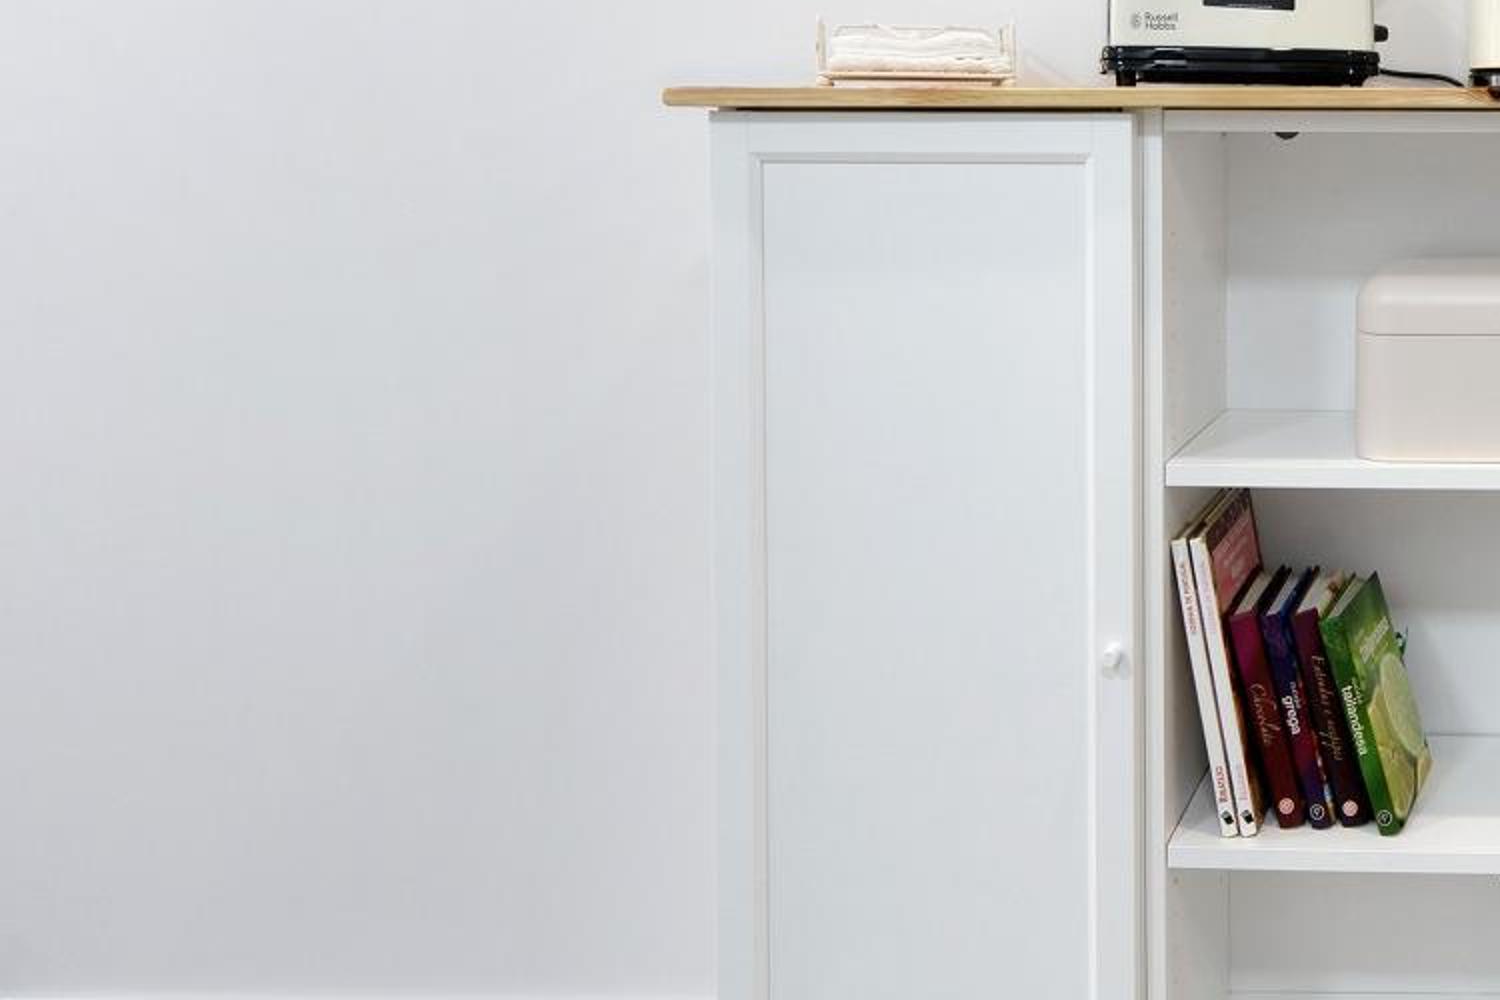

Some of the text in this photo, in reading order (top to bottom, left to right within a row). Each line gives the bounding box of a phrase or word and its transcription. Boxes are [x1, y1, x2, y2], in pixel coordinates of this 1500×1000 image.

[1144, 11, 1179, 22] Russell
[1144, 21, 1176, 31] Hobbs
[1281, 695, 1301, 736] grega
[1341, 684, 1368, 757] tailandesa
